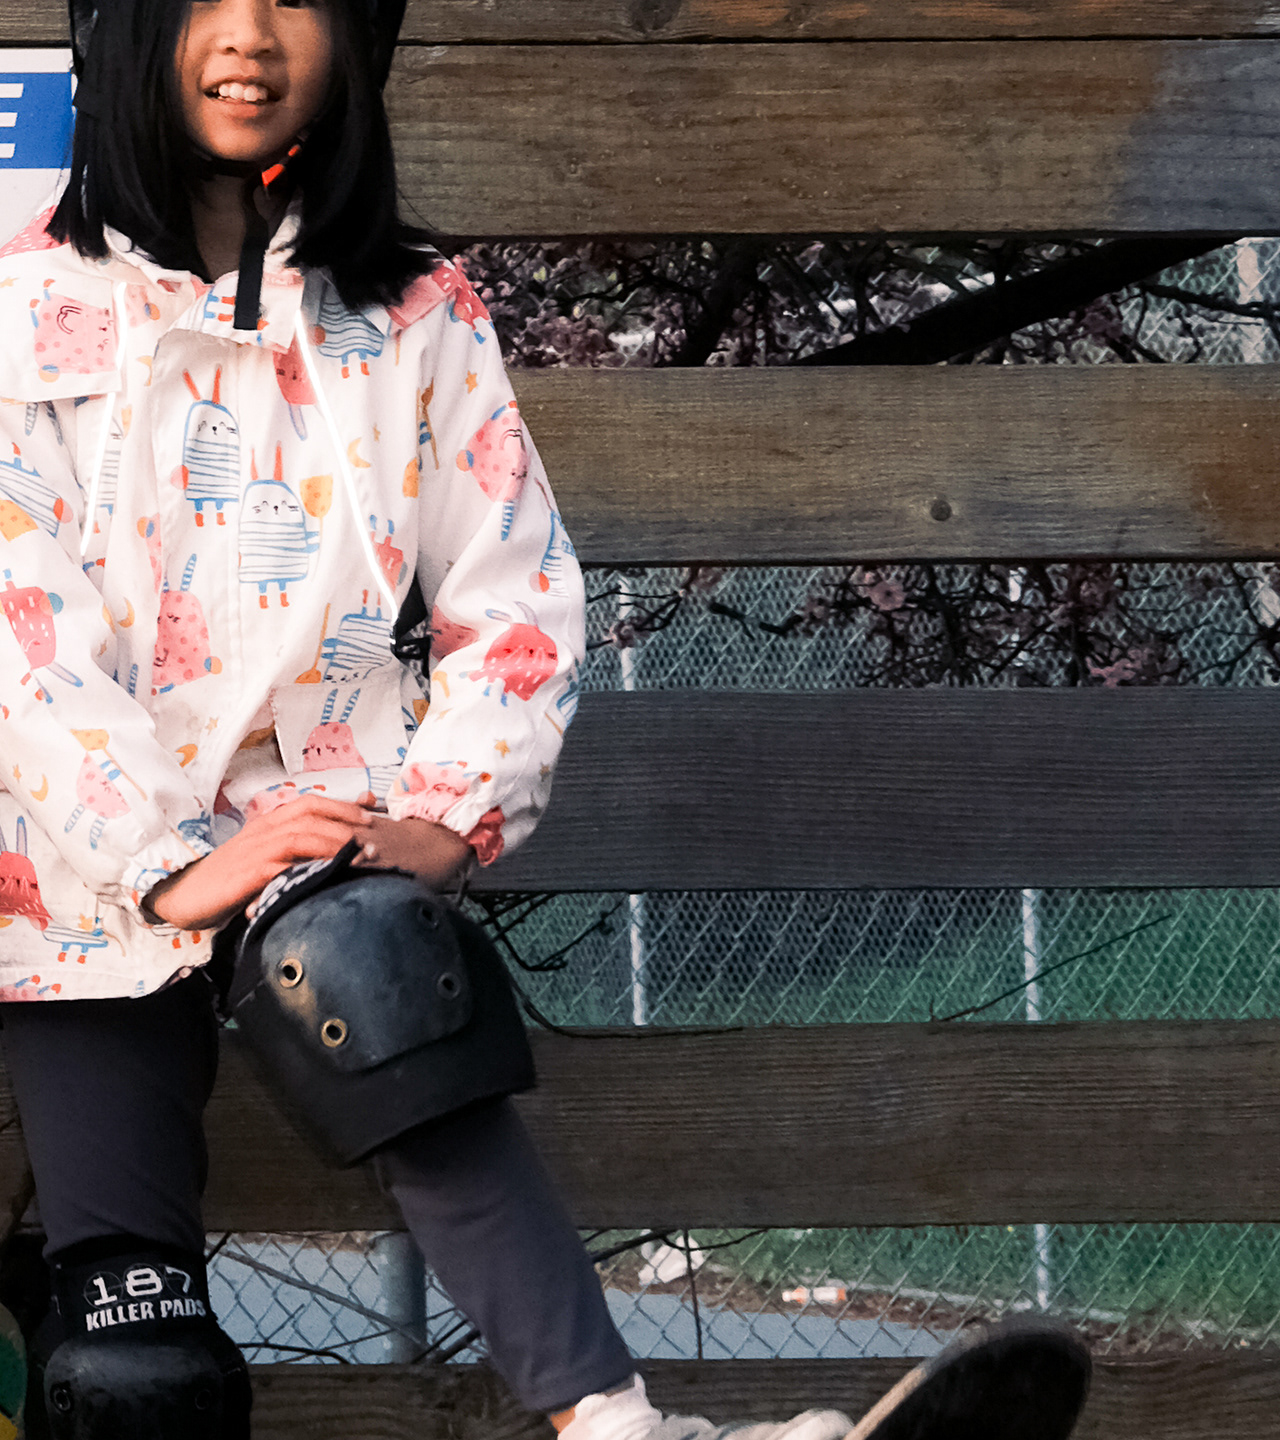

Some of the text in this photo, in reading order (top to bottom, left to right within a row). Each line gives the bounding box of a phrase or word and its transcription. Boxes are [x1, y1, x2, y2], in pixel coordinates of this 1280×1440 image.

[93, 1266, 191, 1306] 187
[86, 1298, 206, 1331] KILLER PADS
